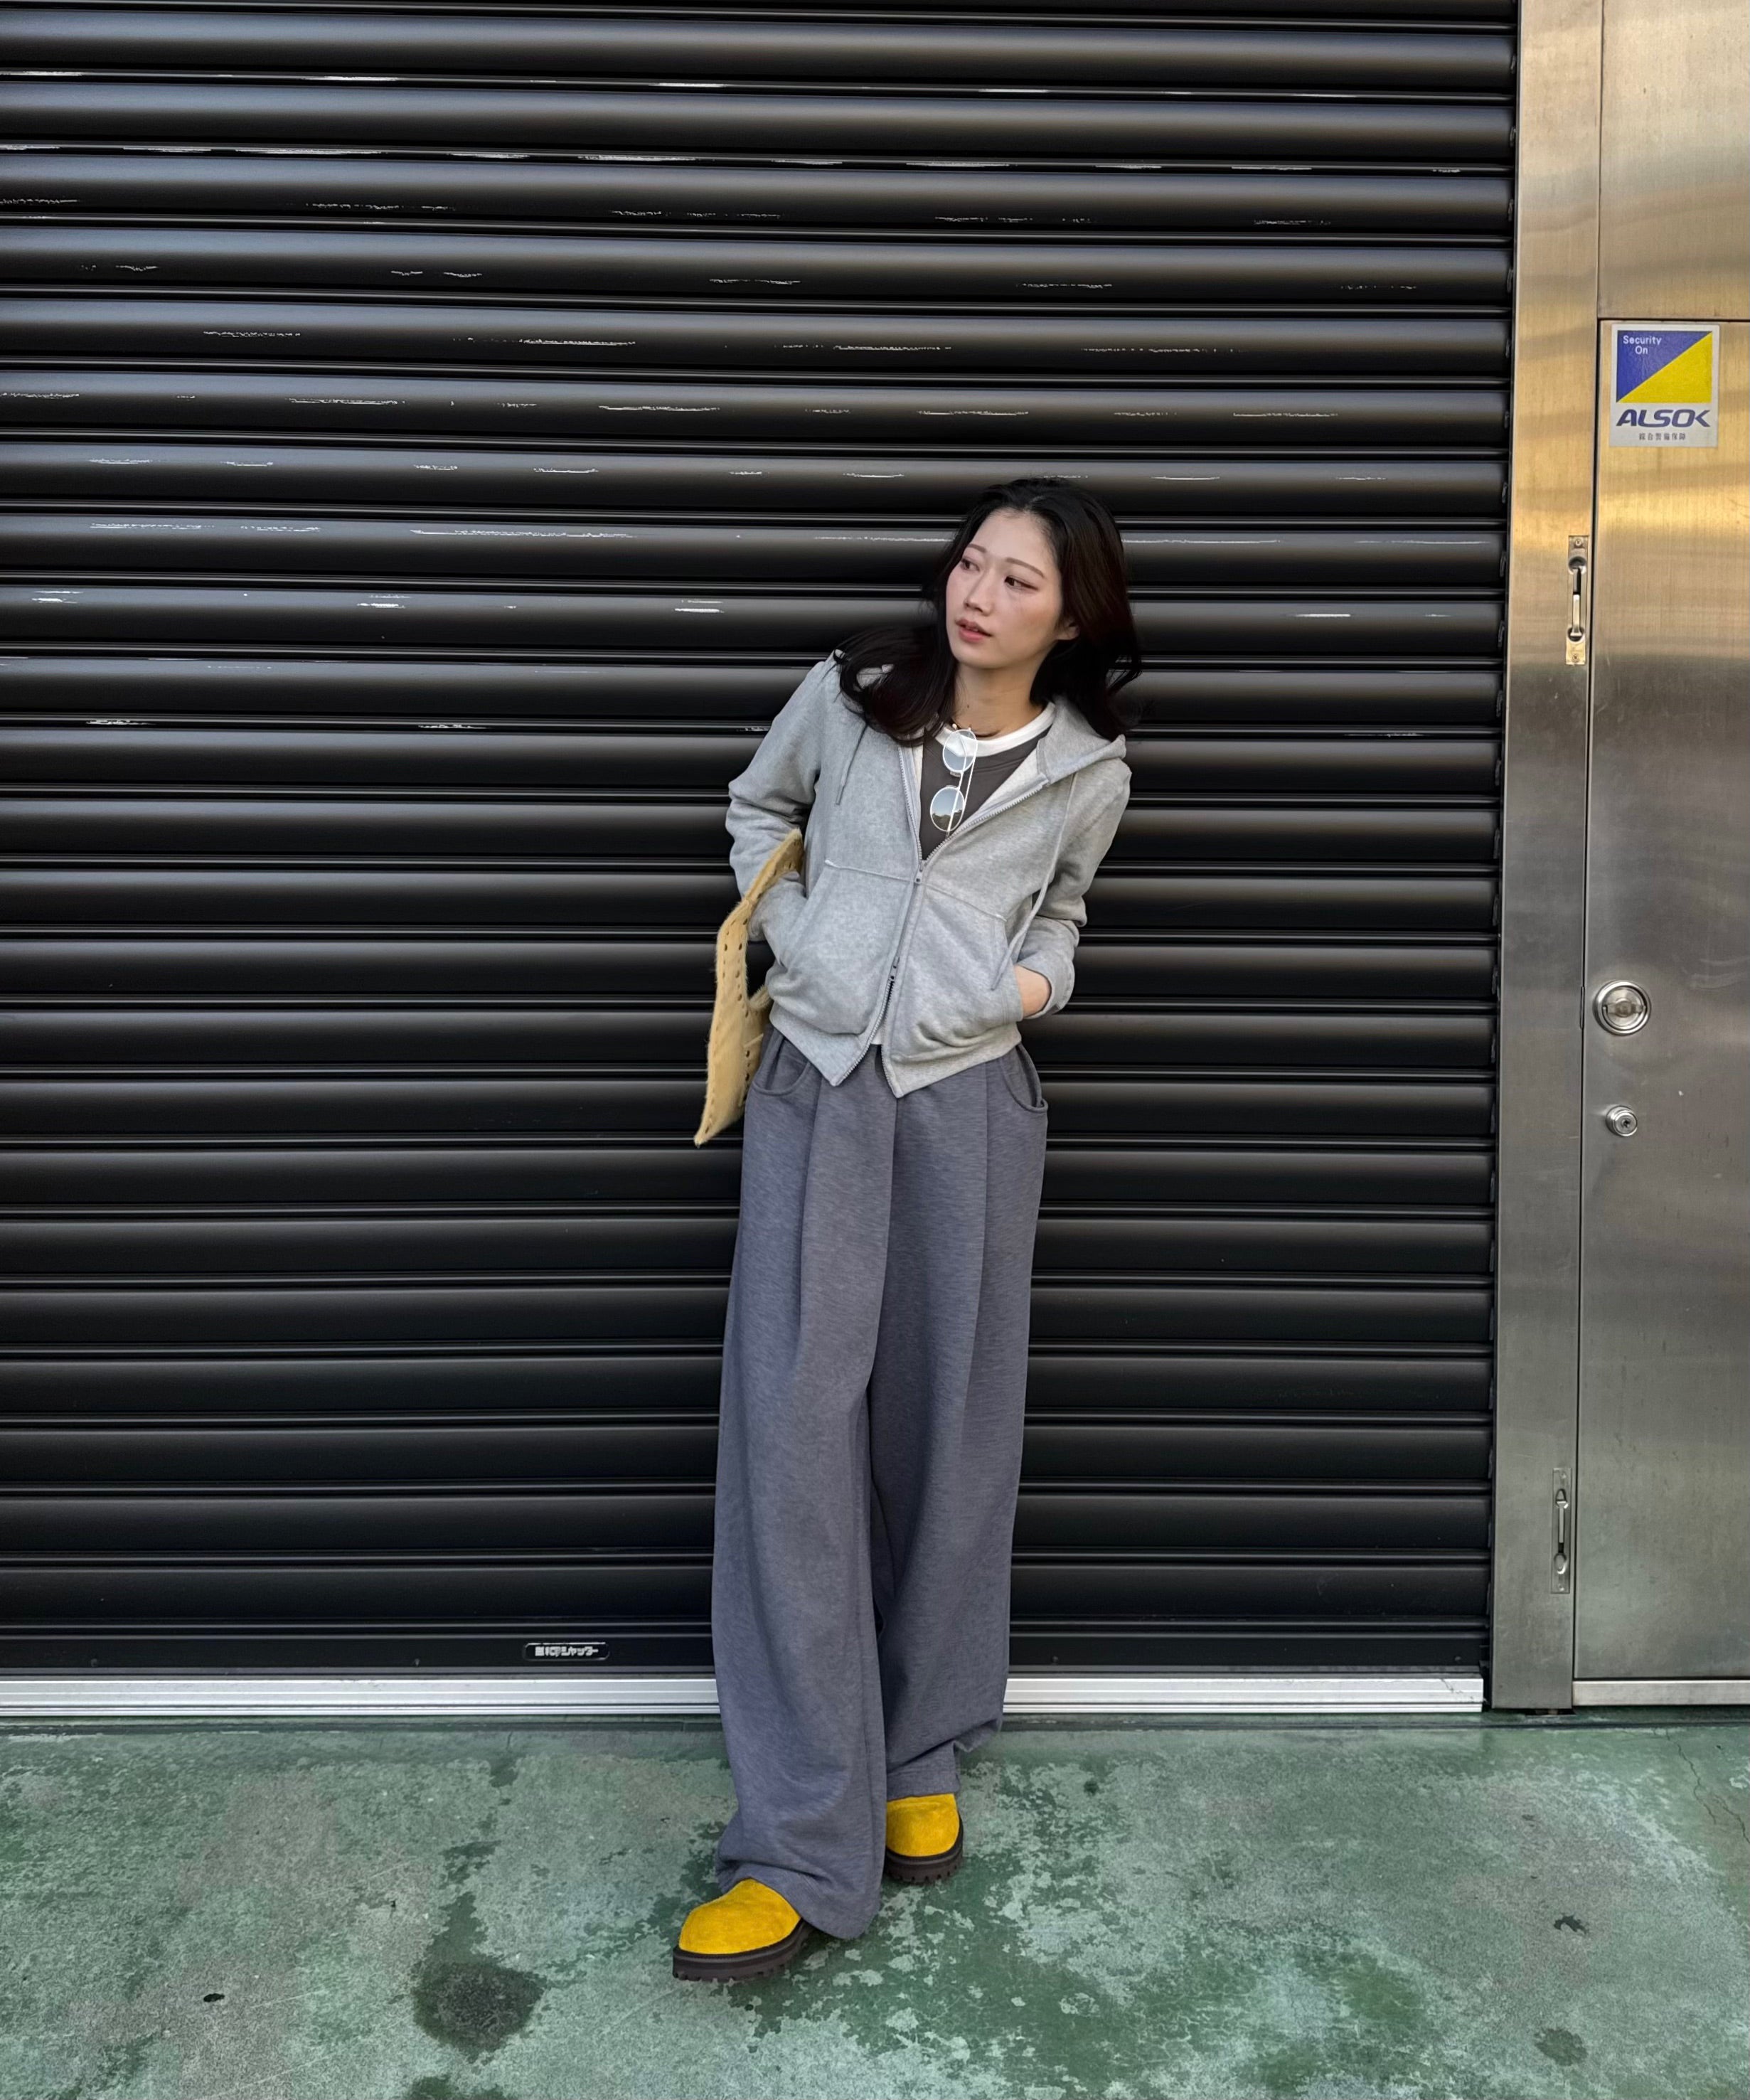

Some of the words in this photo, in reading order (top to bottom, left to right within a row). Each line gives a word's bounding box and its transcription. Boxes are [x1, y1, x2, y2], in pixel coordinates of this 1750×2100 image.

[1623, 335, 1662, 346] Security
[1635, 346, 1648, 355] On
[1616, 409, 1710, 428] ALSOK
